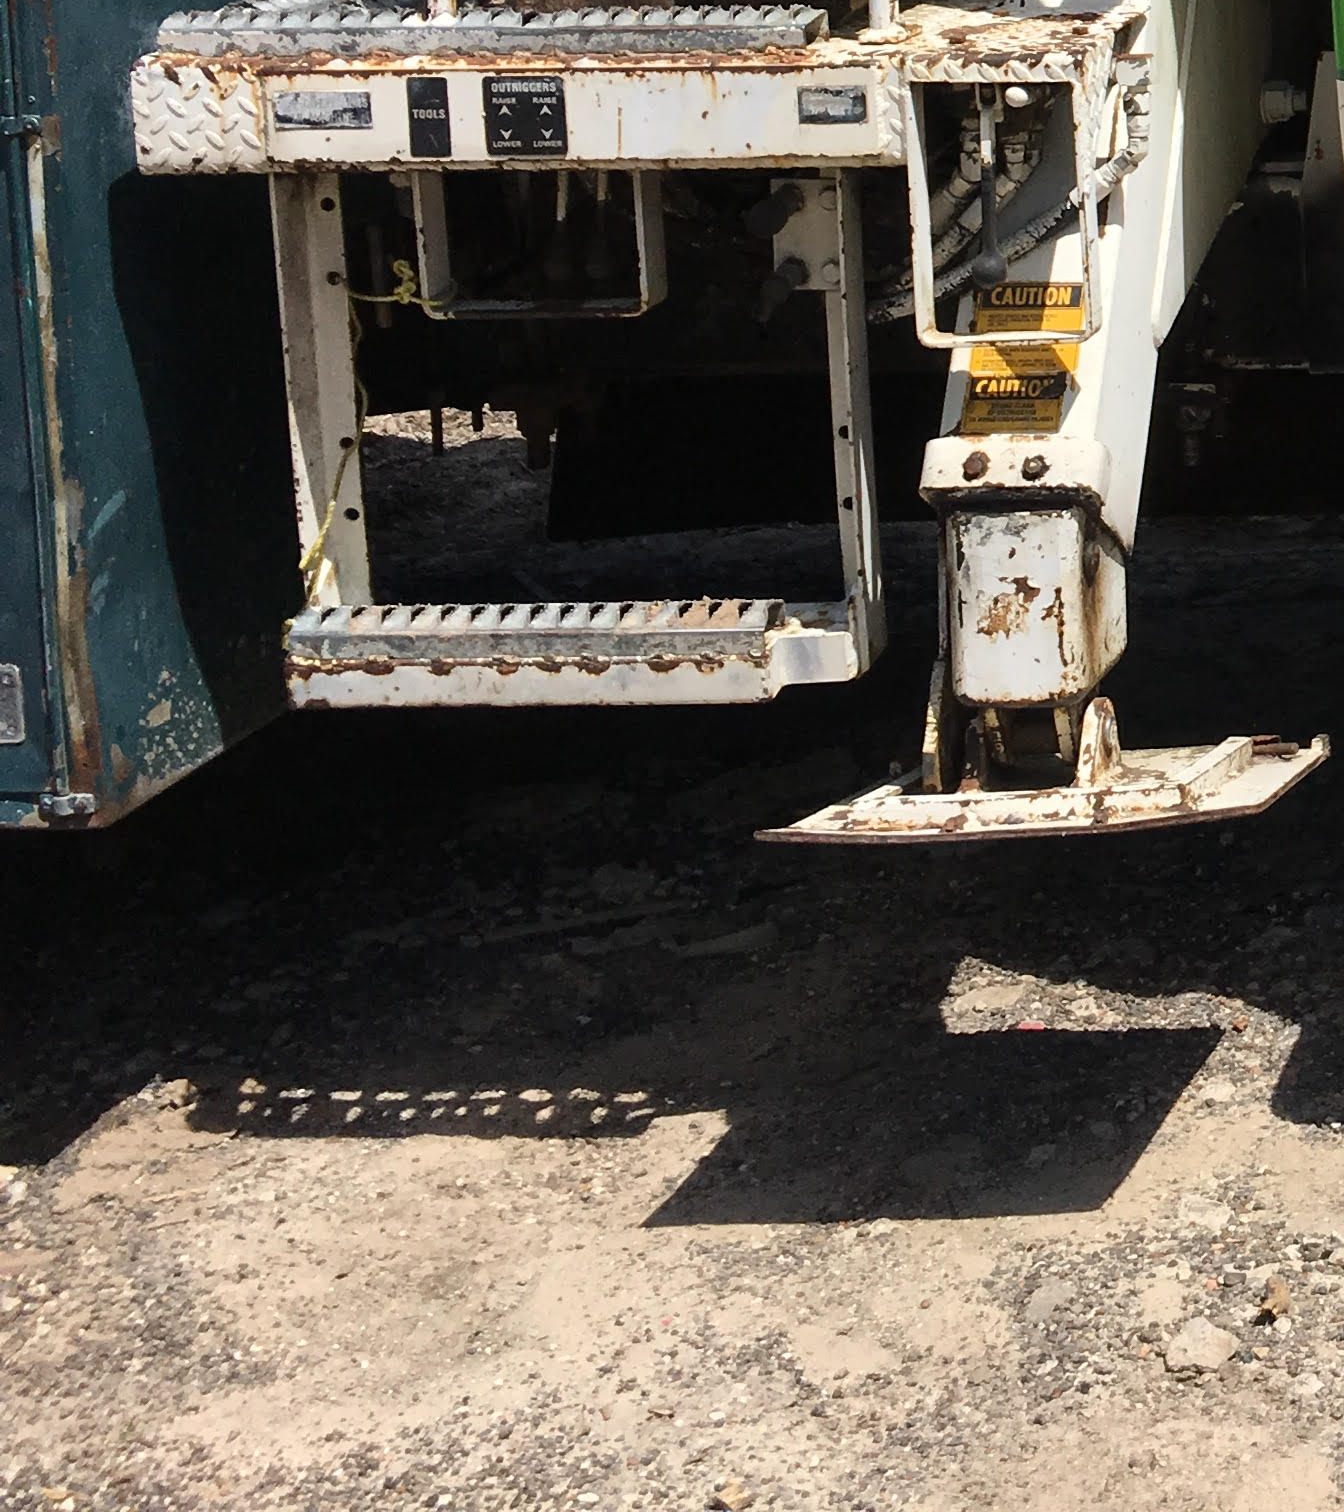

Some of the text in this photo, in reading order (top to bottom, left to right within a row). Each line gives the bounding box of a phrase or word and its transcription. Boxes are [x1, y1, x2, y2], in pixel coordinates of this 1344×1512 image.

[491, 81, 557, 93] OUTRIGGERS
[412, 108, 446, 120] TOOLS
[991, 287, 1073, 306] CAUTION
